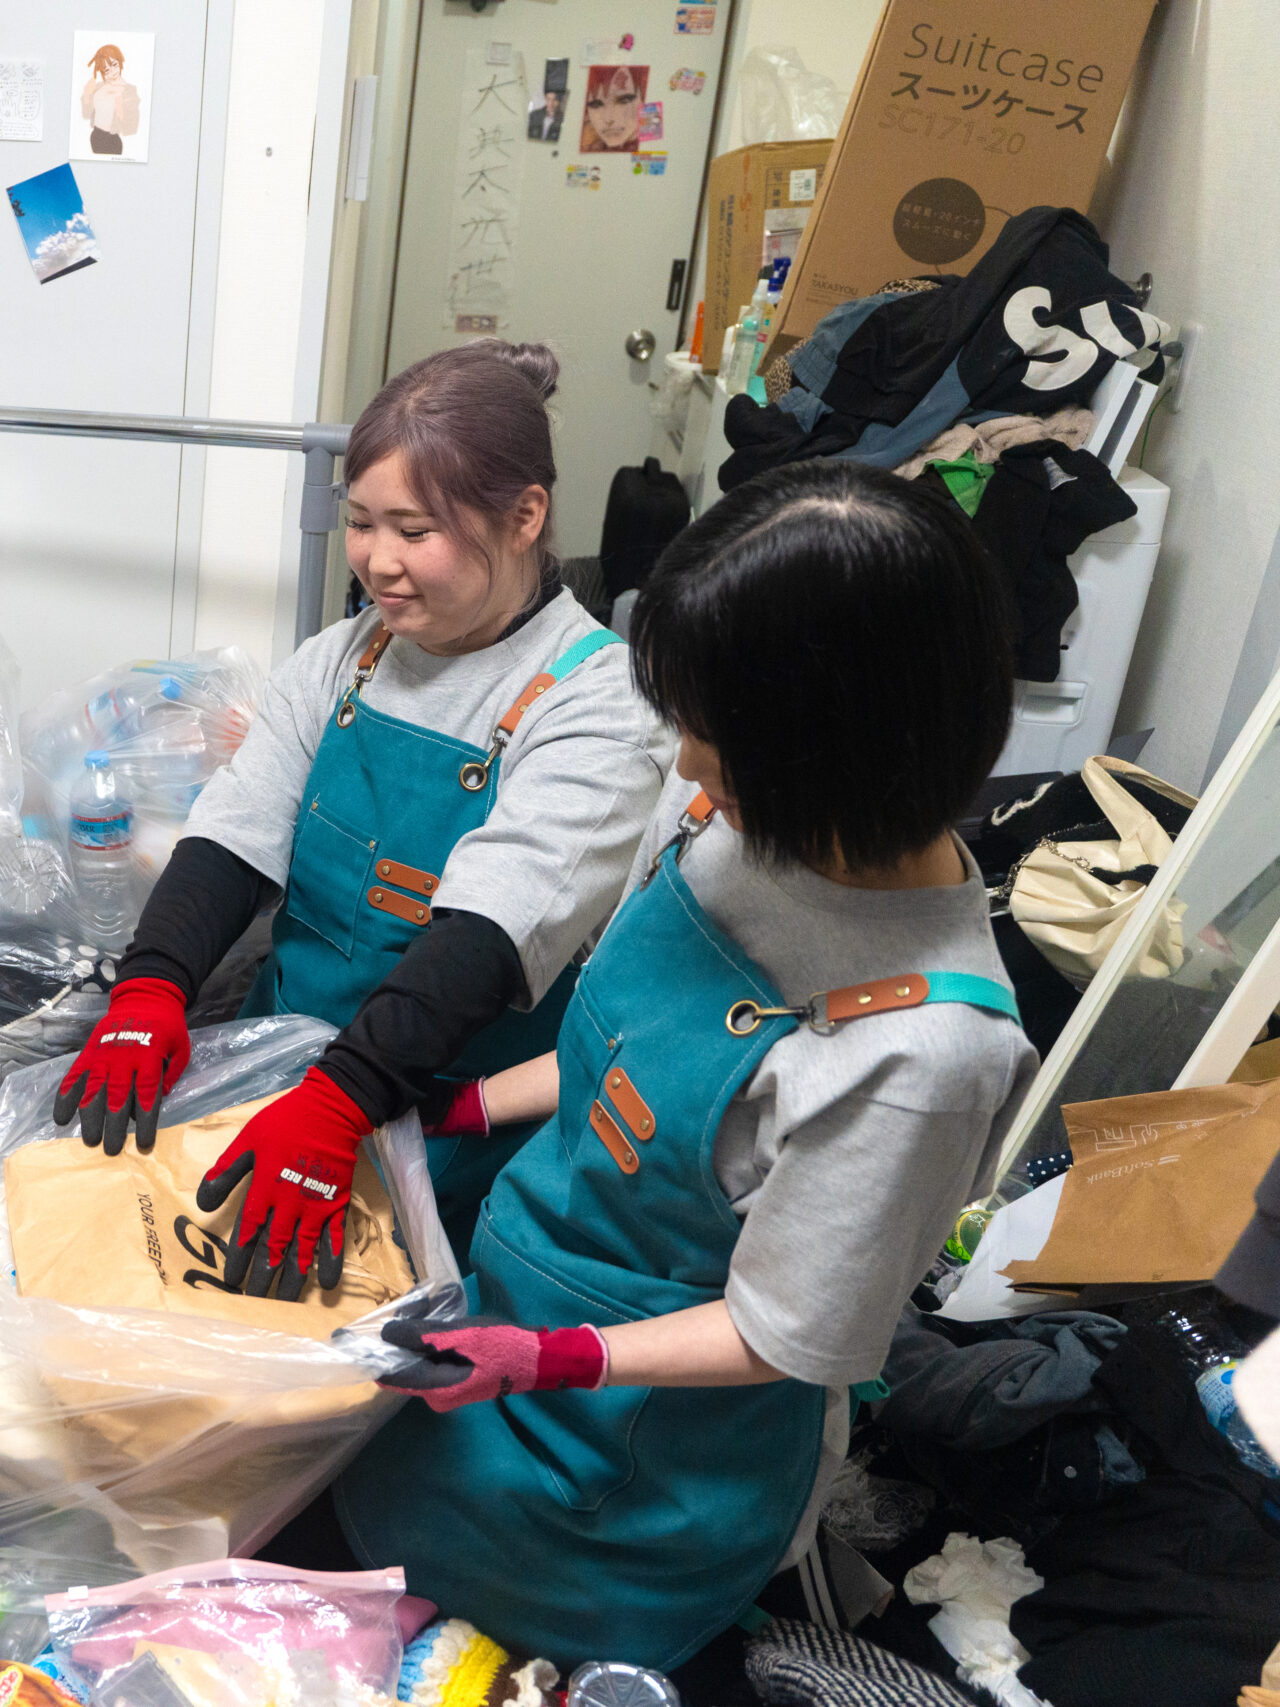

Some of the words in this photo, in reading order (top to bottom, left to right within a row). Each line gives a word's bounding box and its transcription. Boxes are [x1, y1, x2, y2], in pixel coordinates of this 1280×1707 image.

[903, 22, 1104, 94] Suitcase
[890, 71, 1089, 134] スーツケース
[877, 103, 1027, 156] SC171-20
[117, 1031, 152, 1047] TOUGH
[280, 1167, 303, 1184] RED
[302, 1176, 338, 1200] TOUGH
[1086, 1159, 1156, 1185] SoftBank
[136, 1192, 156, 1227] YOUR
[144, 1227, 168, 1286] FREE
